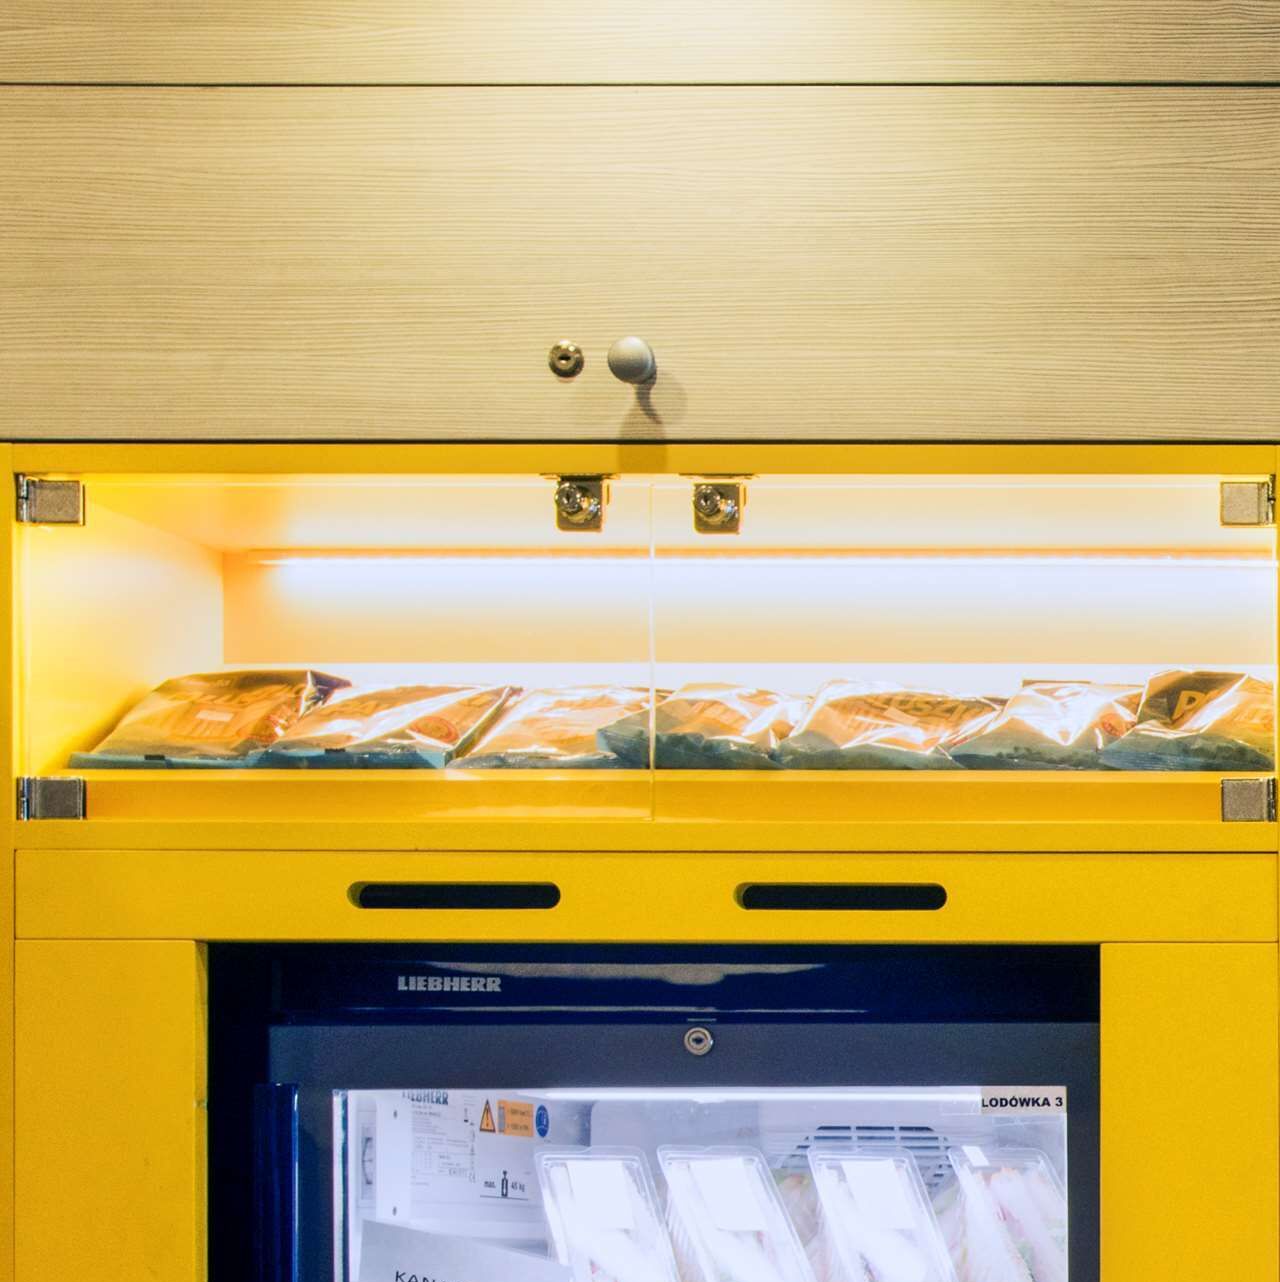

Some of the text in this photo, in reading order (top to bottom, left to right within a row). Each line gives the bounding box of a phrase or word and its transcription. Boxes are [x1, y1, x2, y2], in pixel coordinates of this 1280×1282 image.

[398, 976, 501, 992] LIEBHERR
[981, 1096, 1063, 1108] LODÓWKA 3
